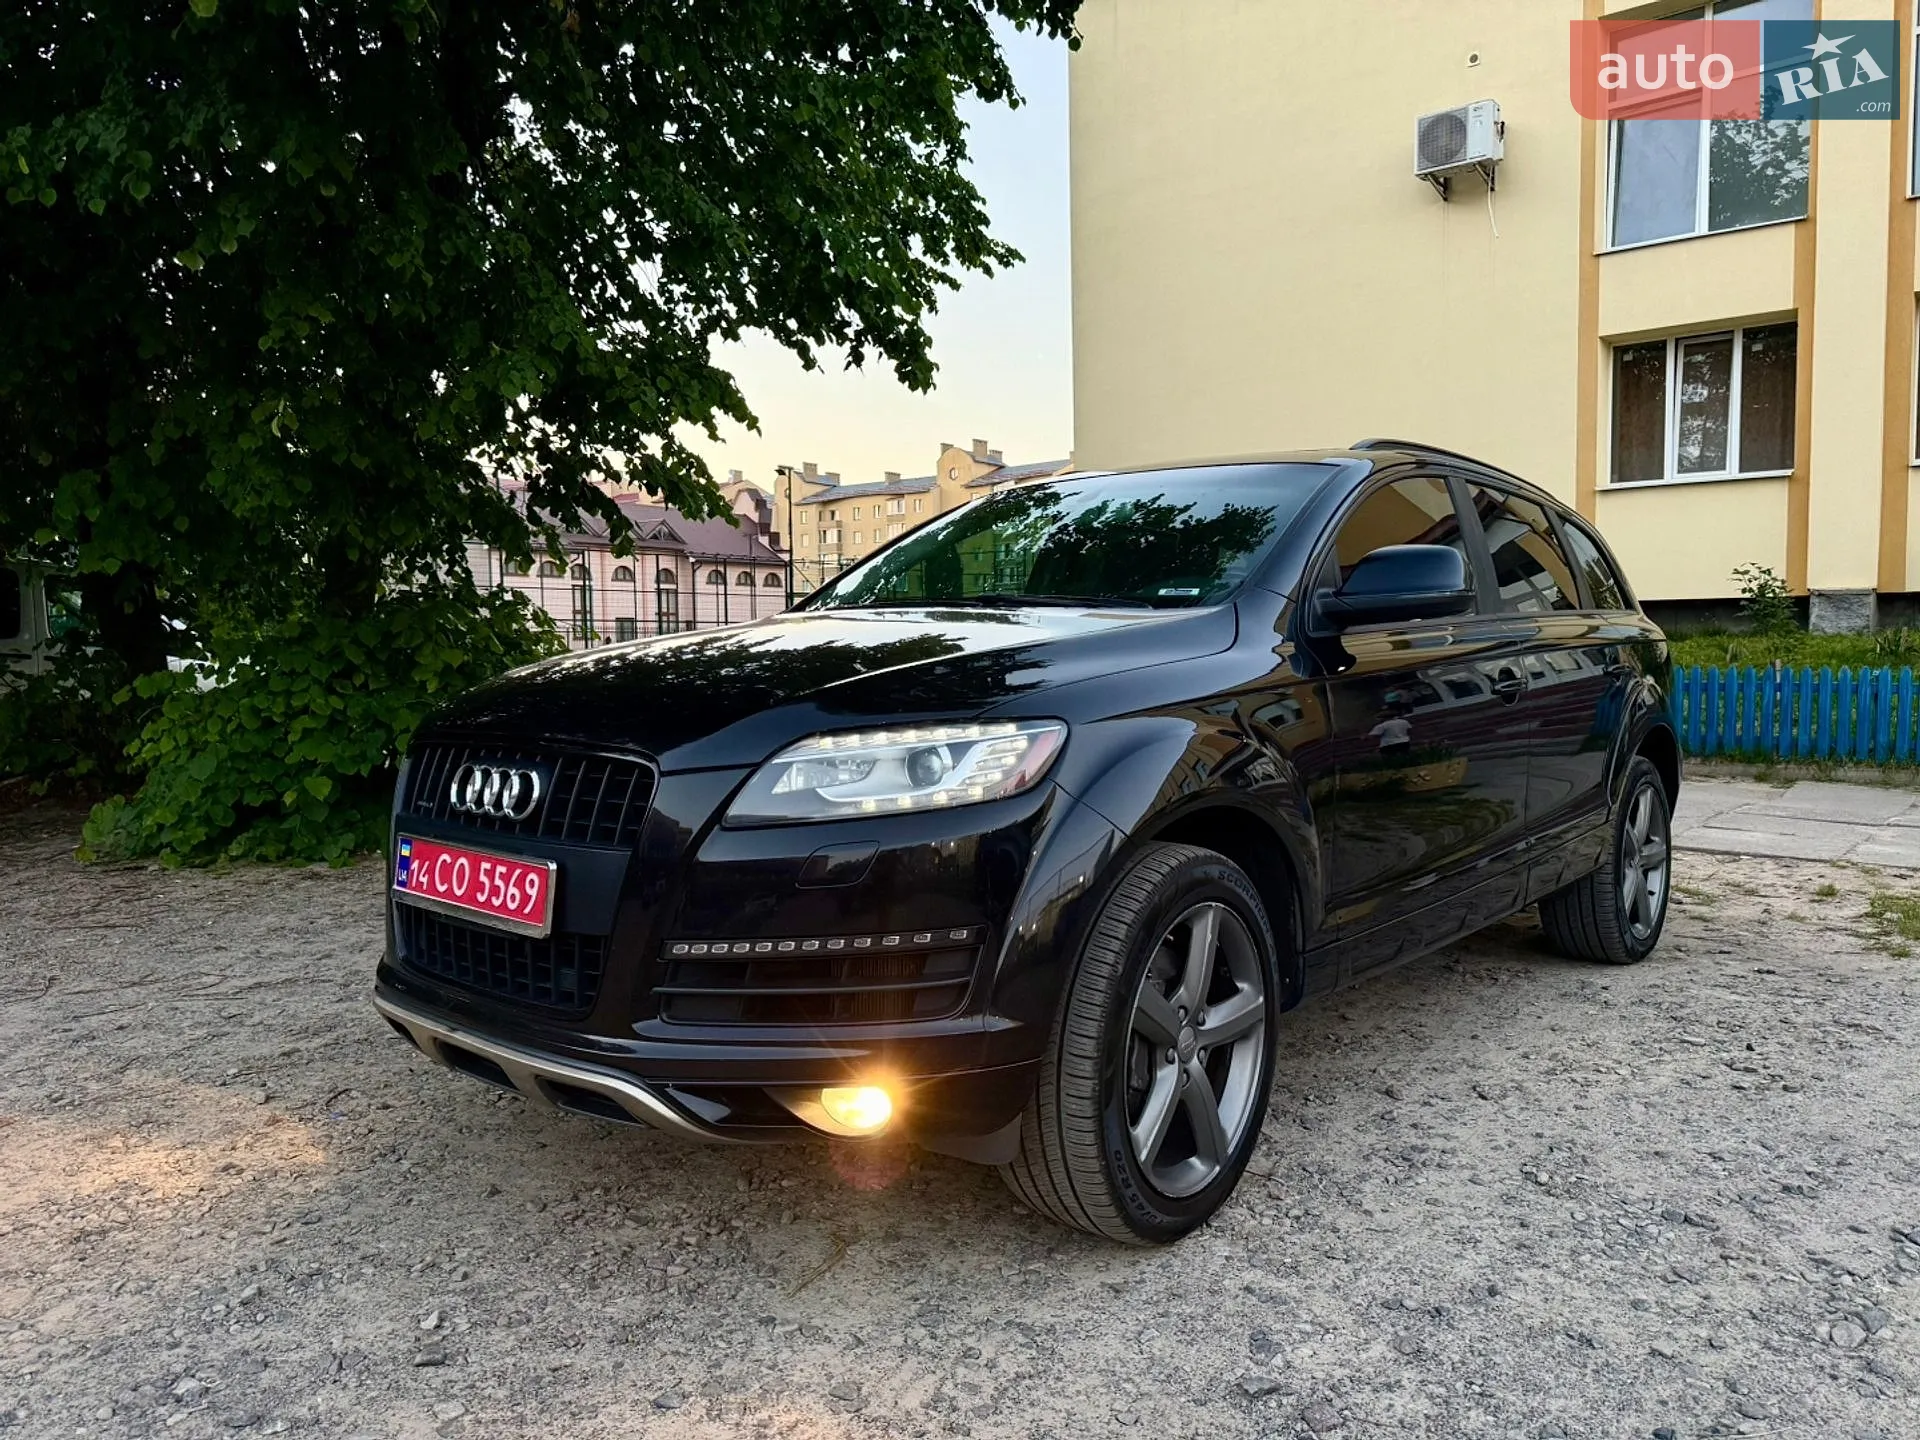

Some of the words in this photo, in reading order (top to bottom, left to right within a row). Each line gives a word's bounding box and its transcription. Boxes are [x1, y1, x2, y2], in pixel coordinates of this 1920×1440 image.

[410, 858, 430, 890] 14
[434, 853, 470, 897] CO
[476, 861, 540, 915] 5569
[1217, 870, 1271, 933] SCORPION
